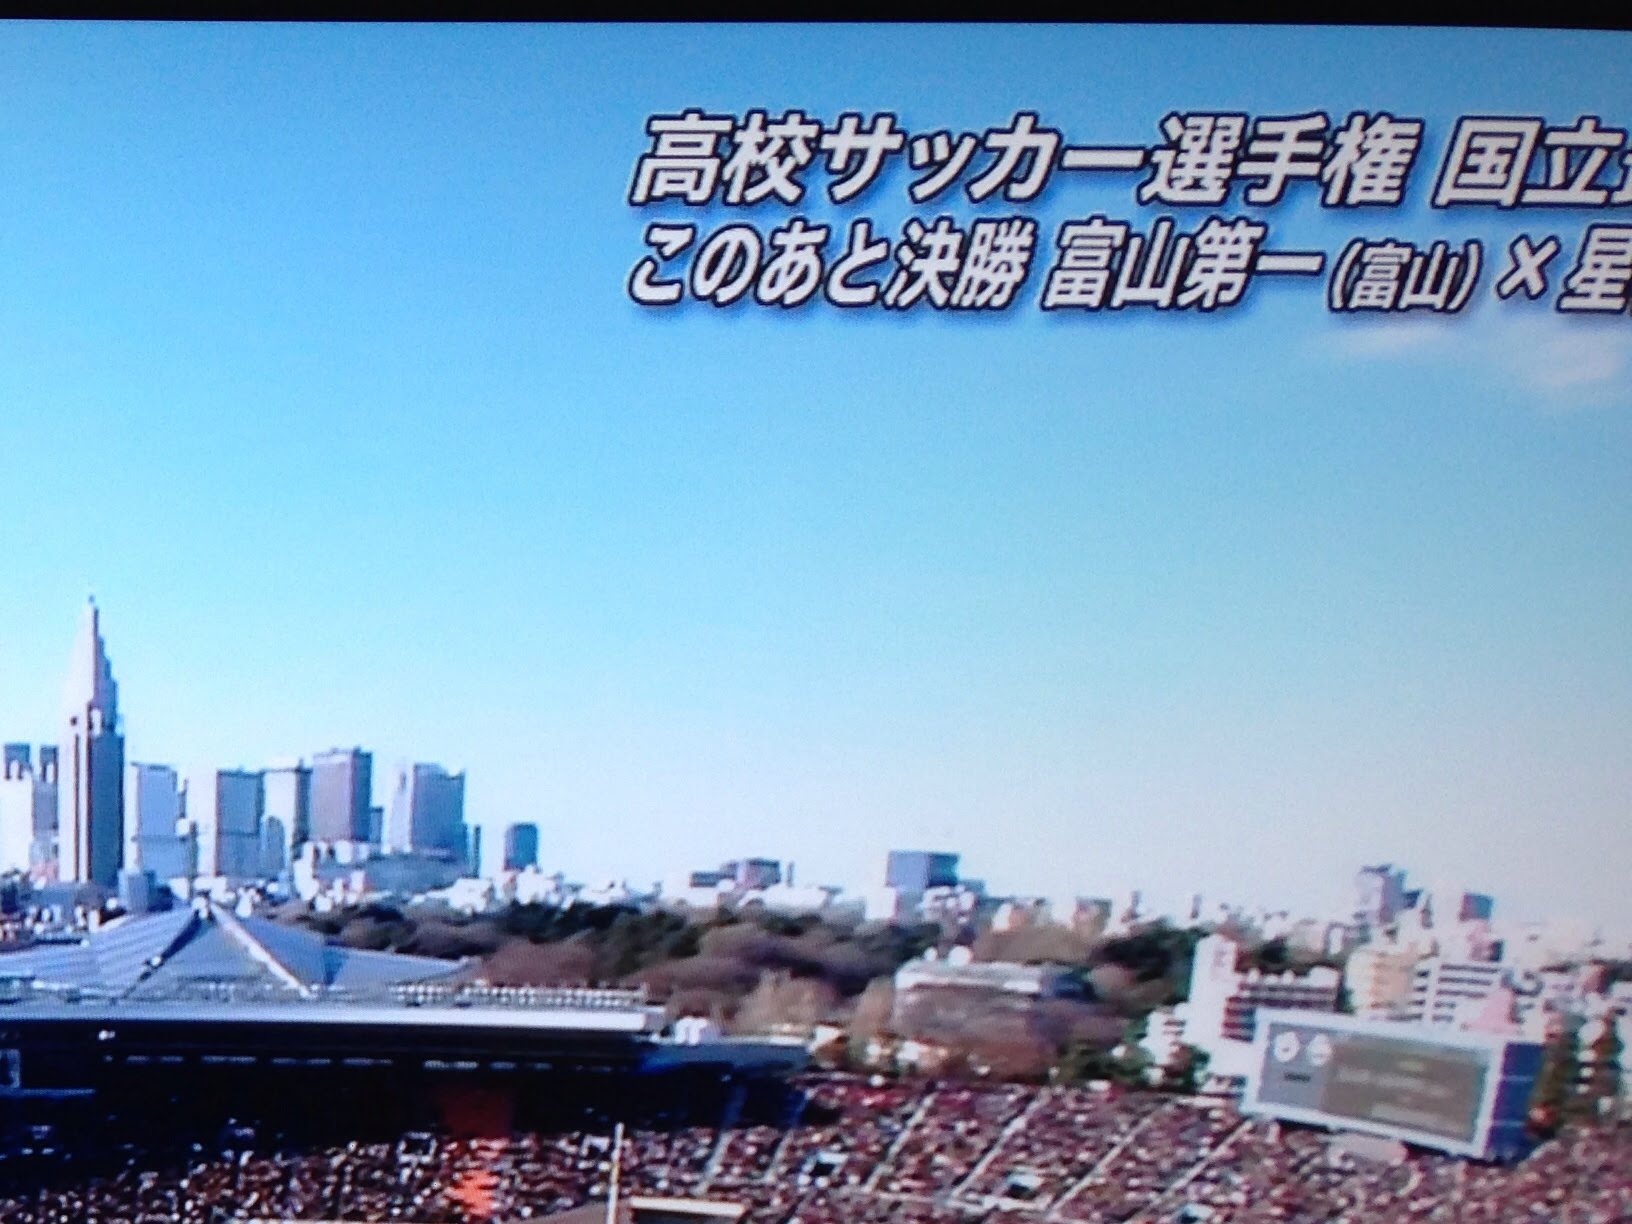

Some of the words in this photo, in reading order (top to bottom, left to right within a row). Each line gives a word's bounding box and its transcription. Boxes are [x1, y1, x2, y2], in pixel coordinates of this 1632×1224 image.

[631, 111, 1423, 208] 高校サッカー選手権
[1431, 115, 1632, 210] 国立
[626, 217, 1042, 310] このあと決勝
